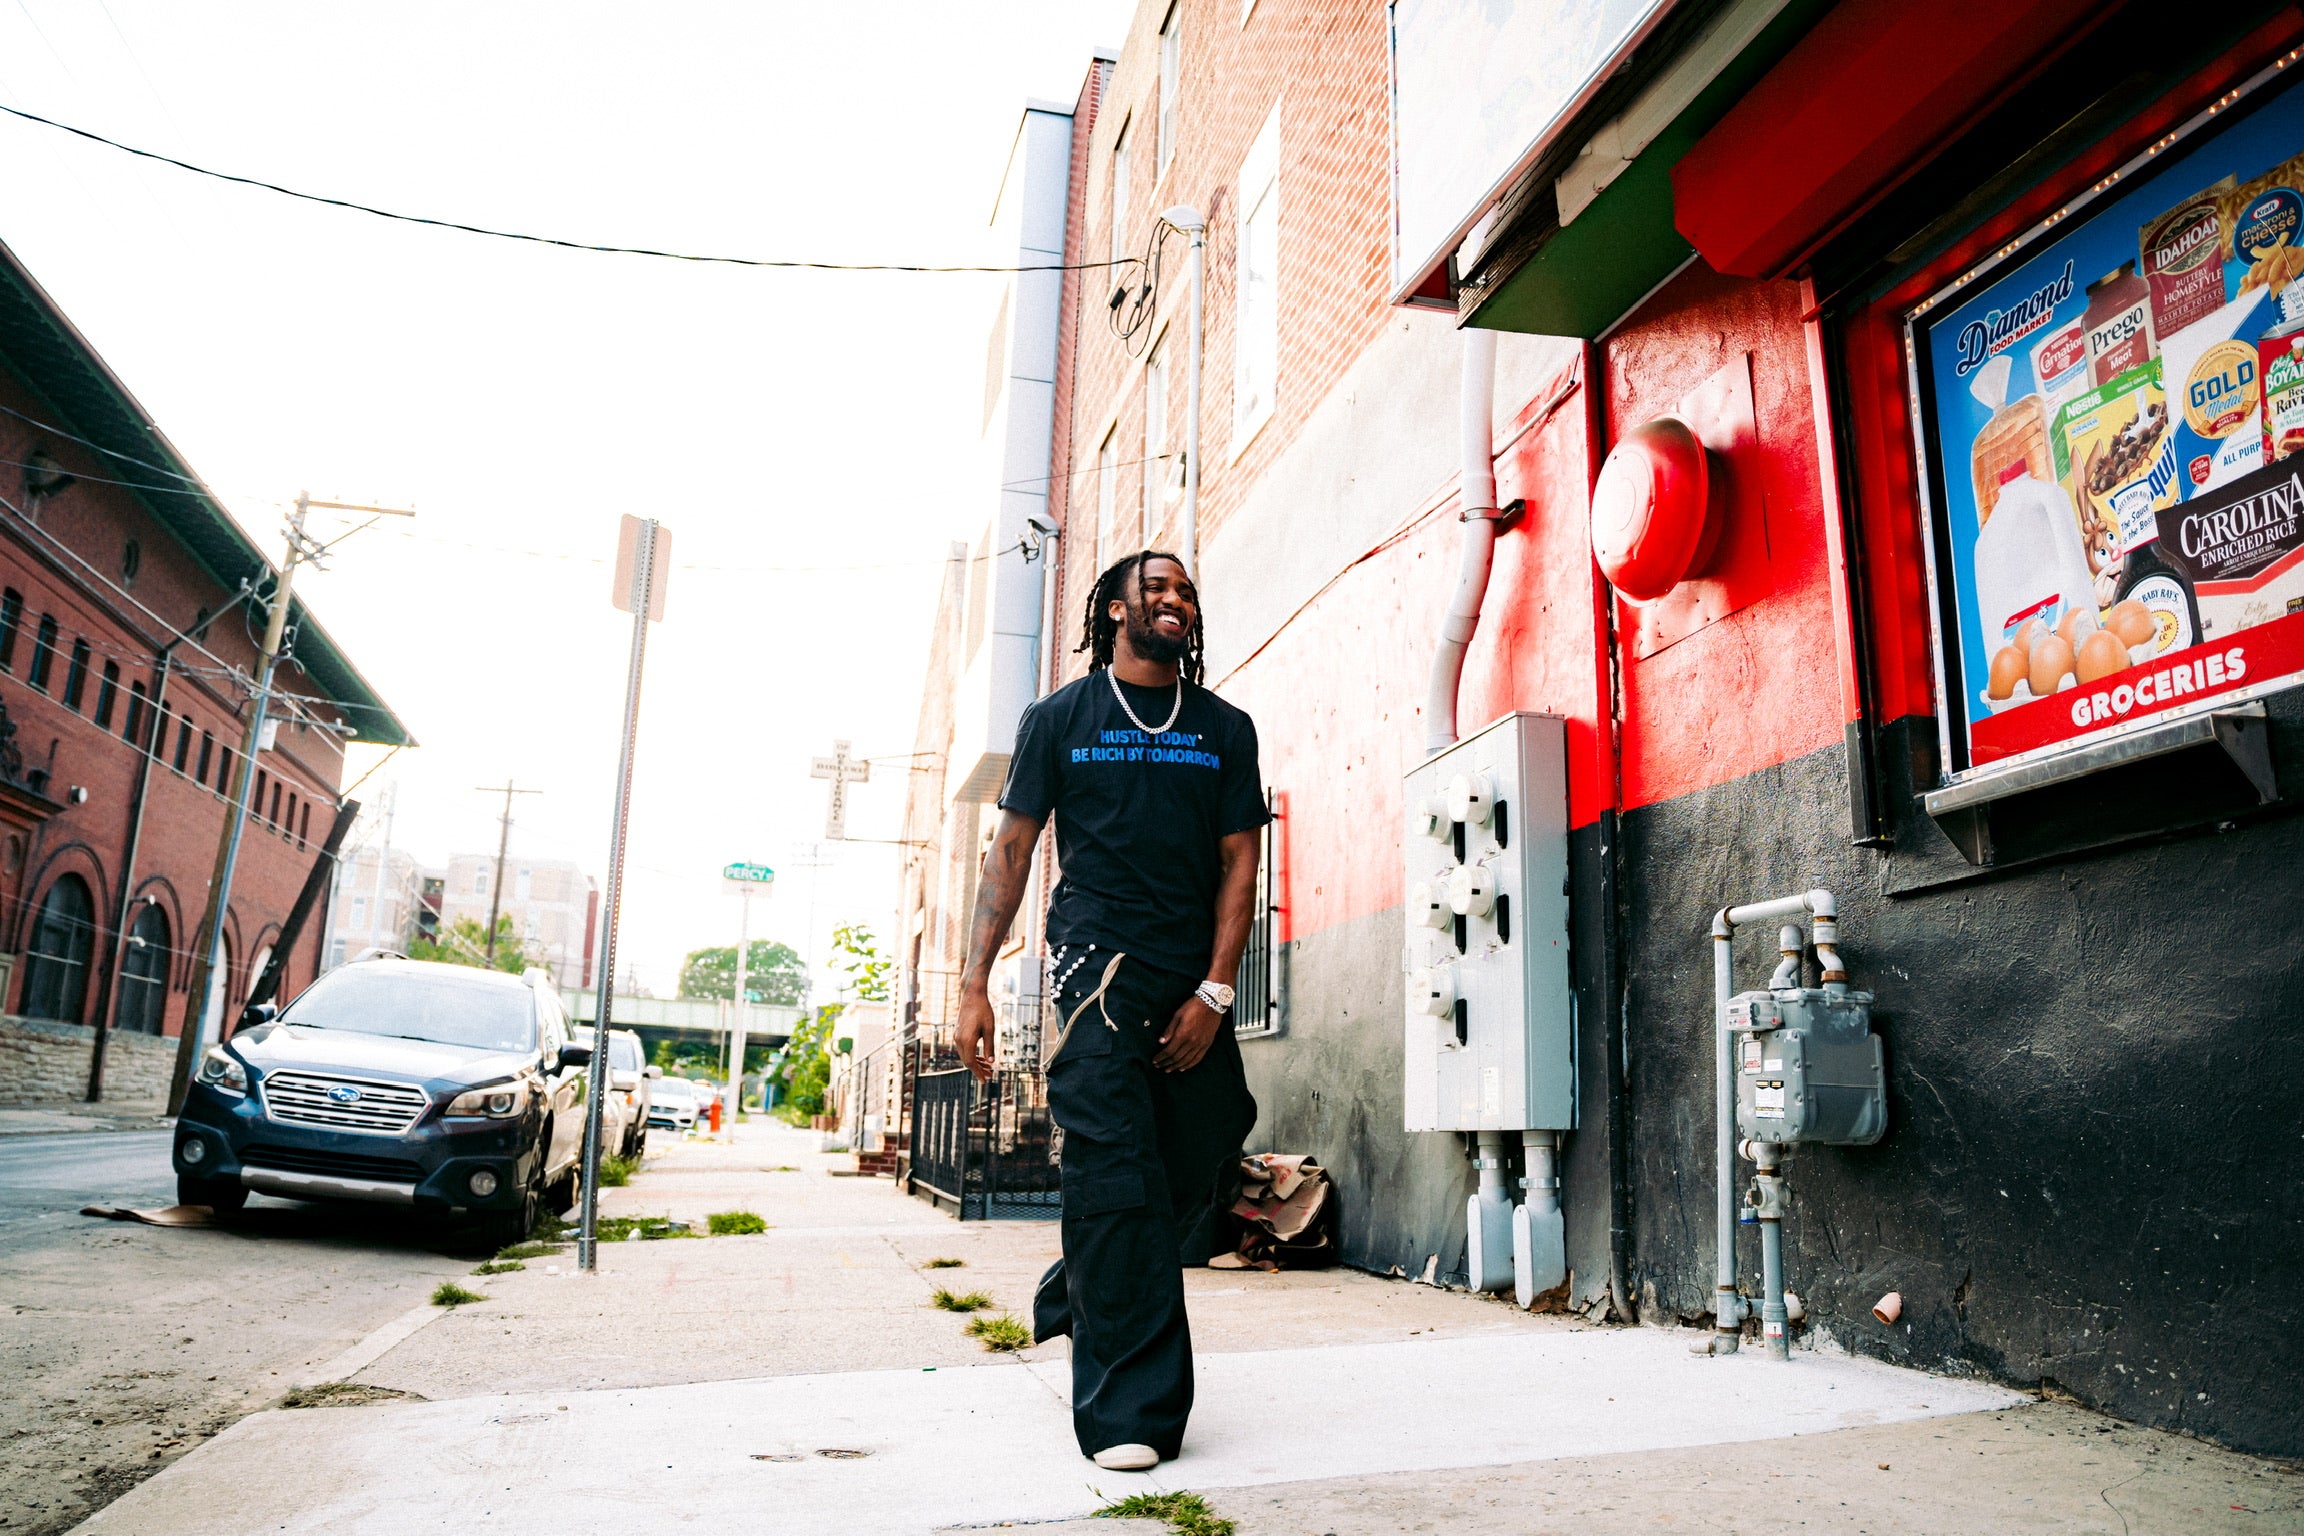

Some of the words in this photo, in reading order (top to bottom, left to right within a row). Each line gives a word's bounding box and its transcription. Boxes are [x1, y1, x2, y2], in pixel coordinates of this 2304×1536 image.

[2256, 202, 2275, 217] Kraft
[2241, 210, 2288, 238] macaroni
[2163, 268, 2222, 306] HOMESTYLE
[2175, 267, 2208, 288] BUTTERY
[1956, 259, 2074, 376] Diamond
[2091, 307, 2144, 356] Prego
[1989, 335, 2014, 356] FOOD
[2015, 310, 2053, 340] MARKET
[2110, 348, 2132, 370] Meat
[2189, 360, 2255, 409] GOLD
[2205, 388, 2244, 419] Medal
[2223, 452, 2237, 467] ALL
[2131, 504, 2149, 523] Sauce
[2180, 472, 2304, 558] CAROLINA
[2201, 532, 2264, 569] ENRICHED
[2265, 519, 2297, 545] RICE
[2142, 589, 2159, 603] BABY
[2160, 588, 2179, 603] RAY'S
[2071, 647, 2247, 727] GROCERIES
[1100, 729, 1150, 744] HUSTLE
[1154, 731, 1197, 746] TODAY
[1071, 747, 1090, 763] BE
[1091, 746, 1125, 762] RICH
[1126, 746, 1145, 762] BY
[1145, 747, 1220, 770] TOMORROW
[727, 867, 764, 880] PERCY
